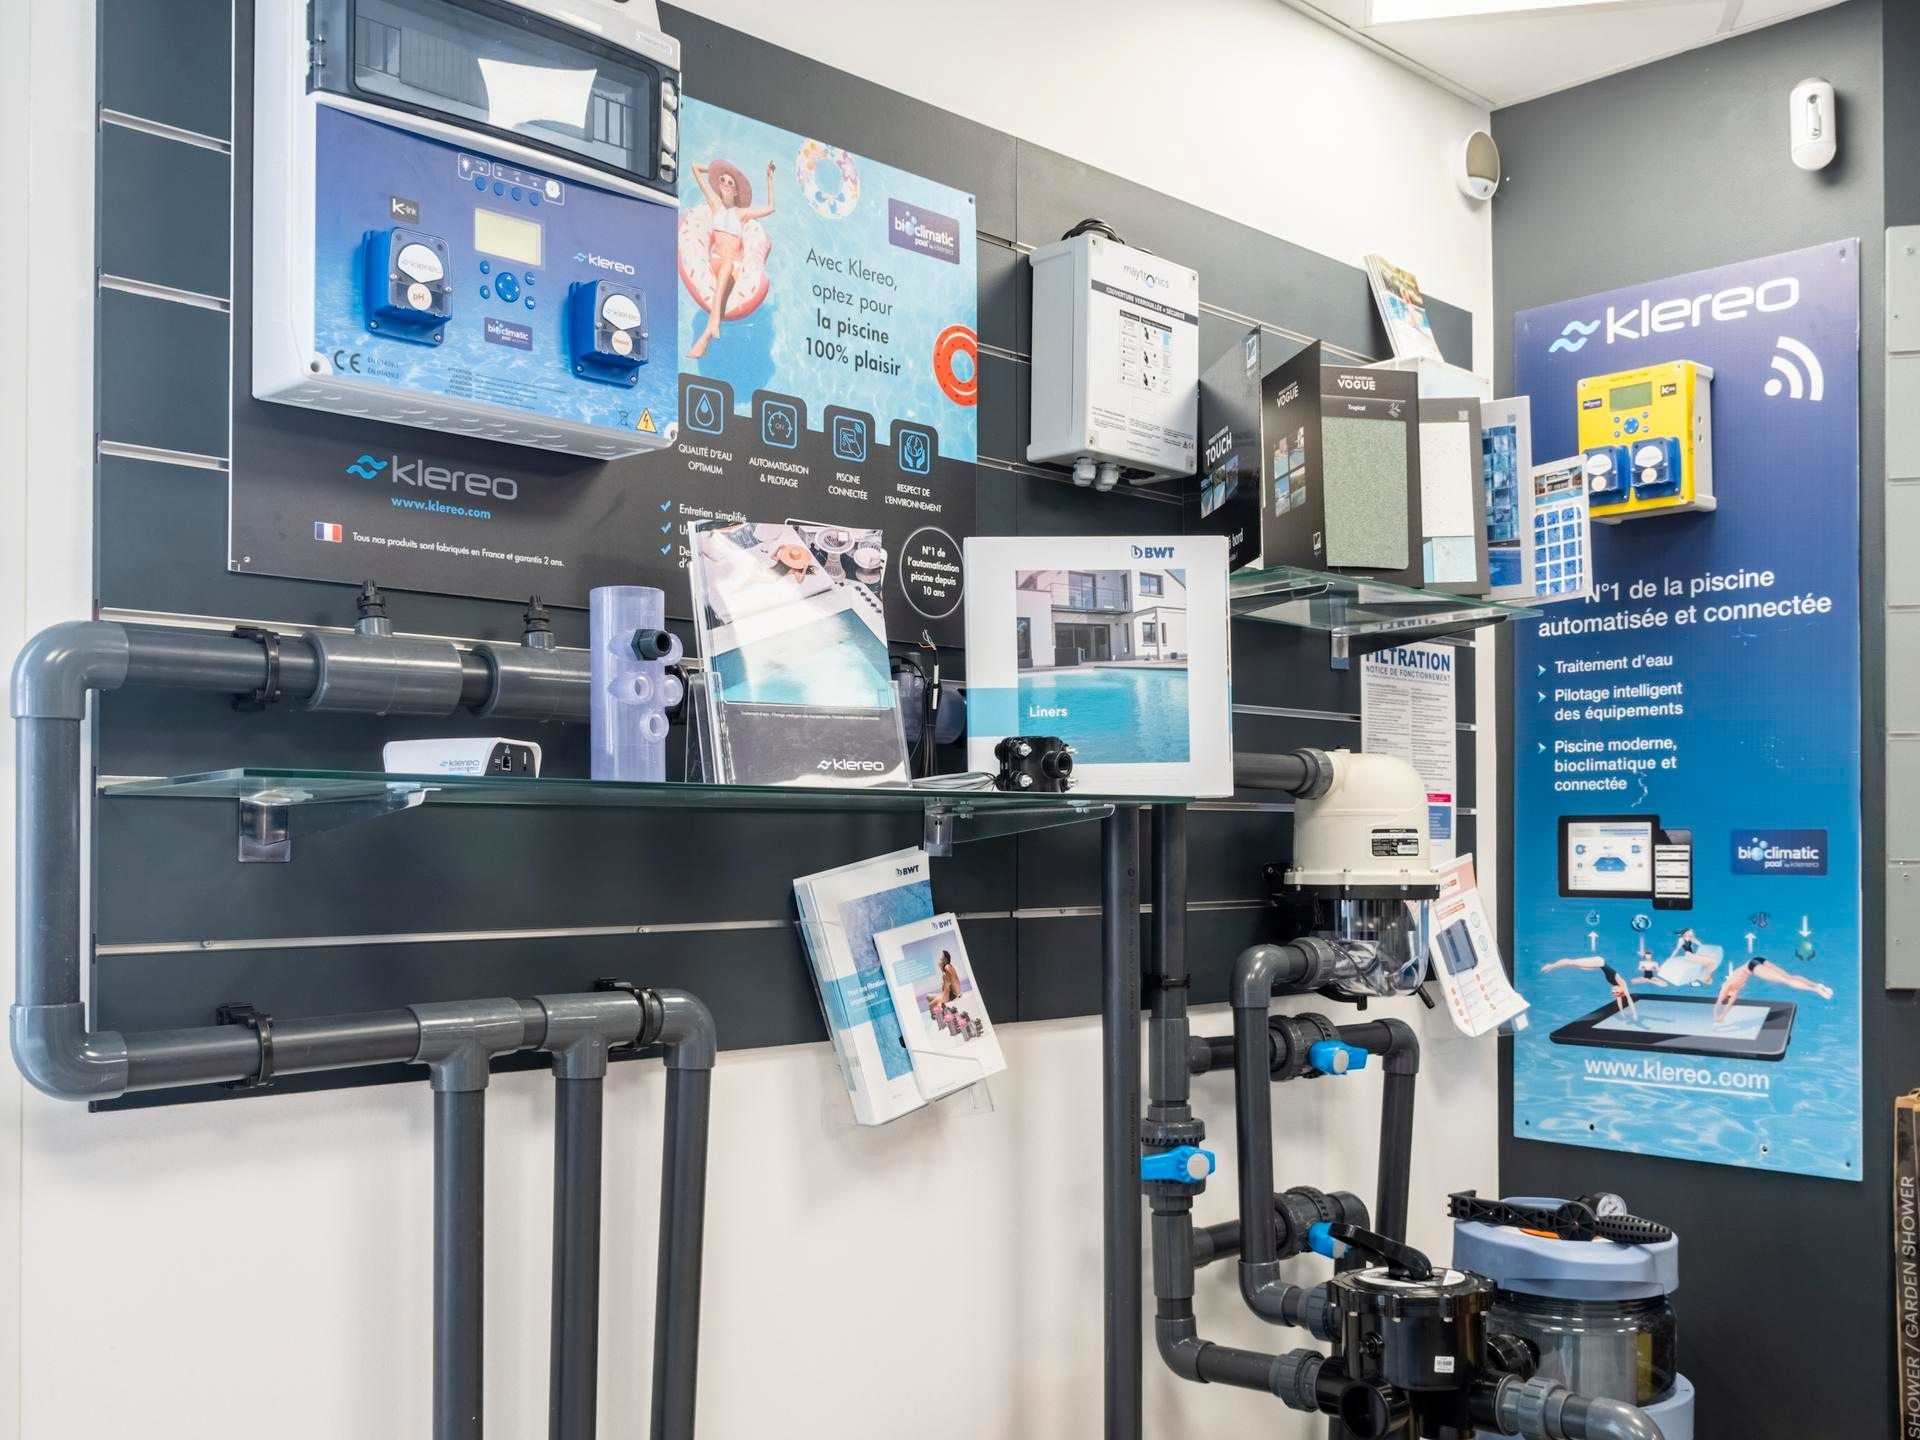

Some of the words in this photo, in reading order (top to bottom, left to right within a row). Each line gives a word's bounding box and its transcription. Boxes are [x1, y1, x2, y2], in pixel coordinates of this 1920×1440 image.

[588, 253, 635, 275] klereo
[806, 248, 843, 273] Avec
[849, 258, 898, 291] Klereo,
[1123, 263, 1170, 288] maytronics
[413, 291, 425, 303] pH
[813, 284, 853, 306] optez
[860, 296, 893, 316] pour
[1606, 277, 1799, 344] klereo
[817, 308, 831, 330] la
[837, 317, 890, 344] piscine
[806, 337, 849, 364] 100%
[855, 350, 902, 376] plaisir
[1338, 379, 1376, 391] VOGUE
[1276, 385, 1299, 408] VOGUE
[1348, 404, 1366, 412] Tropical
[678, 442, 708, 458] QUALITÉ
[710, 449, 733, 462] D'EAU
[1206, 432, 1232, 466] TOUCH
[688, 461, 723, 475] OPTIMUM
[749, 457, 809, 475] AUTOMATISATION
[391, 454, 518, 500] klereo
[760, 473, 766, 482] &
[767, 474, 799, 488] PILOTAGE
[836, 472, 861, 485] PISCINE
[828, 485, 868, 500] CONNECTÉE
[896, 483, 921, 496] RESPECT
[922, 488, 931, 497] DE
[391, 497, 491, 520] www.klereo.com
[884, 495, 942, 512] L'ENVIRONNEMENT
[679, 503, 713, 518] Entretien
[715, 509, 747, 523] simplifié
[353, 532, 370, 544] Tous
[372, 536, 386, 546] nos
[387, 537, 418, 550] produits
[419, 541, 435, 551] sont
[436, 542, 470, 558] fabriqués
[471, 548, 480, 556] en
[481, 548, 505, 560] France
[506, 551, 513, 560] et
[514, 552, 543, 565] garantis
[543, 556, 549, 565] 2
[550, 558, 564, 567] ans.
[922, 545, 935, 556] N°1
[937, 547, 946, 558] de
[1144, 546, 1174, 559] BWT
[907, 556, 960, 573] l'automatisation
[910, 571, 933, 583] piscine
[935, 574, 956, 587] depuis
[1585, 583, 1619, 604] N°1
[1629, 579, 1657, 600] de
[1664, 576, 1683, 596] la
[1690, 568, 1775, 598] piscine
[923, 586, 931, 596] 10
[933, 589, 945, 598] ans
[1538, 609, 1668, 638] automatisée
[1675, 605, 1697, 625] et
[1703, 593, 1832, 623] connectée
[1366, 647, 1451, 672] FILTRATION
[1555, 655, 1628, 675] Traitement
[1632, 653, 1673, 669] d'eau
[1366, 665, 1389, 676] NOTICE
[1390, 668, 1398, 677] DE
[1399, 669, 1451, 682] FONCTIONNEMENT
[1555, 685, 1610, 704] Pilotage
[1613, 681, 1683, 700] intelligent
[1029, 706, 1068, 718] Liners
[1555, 708, 1580, 722] des
[1585, 702, 1684, 721] équipements
[1555, 739, 1604, 754] Piscine
[1608, 738, 1678, 752] moderne,
[449, 759, 480, 767] klereo
[832, 758, 885, 772] klereo
[1555, 757, 1656, 774] bioclimatique
[1661, 756, 1677, 769] et
[1555, 777, 1628, 792] connectée
[1737, 844, 1820, 862] bioclimatic
[903, 865, 920, 876] BWT
[1764, 860, 1783, 870] pool
[1790, 859, 1820, 869] klereo
[938, 919, 953, 930] BWT
[1584, 1057, 1770, 1090] www.klereo.com
[1901, 1175, 1916, 1257] SHOWER
[1904, 1260, 1919, 1339] GARDEN
